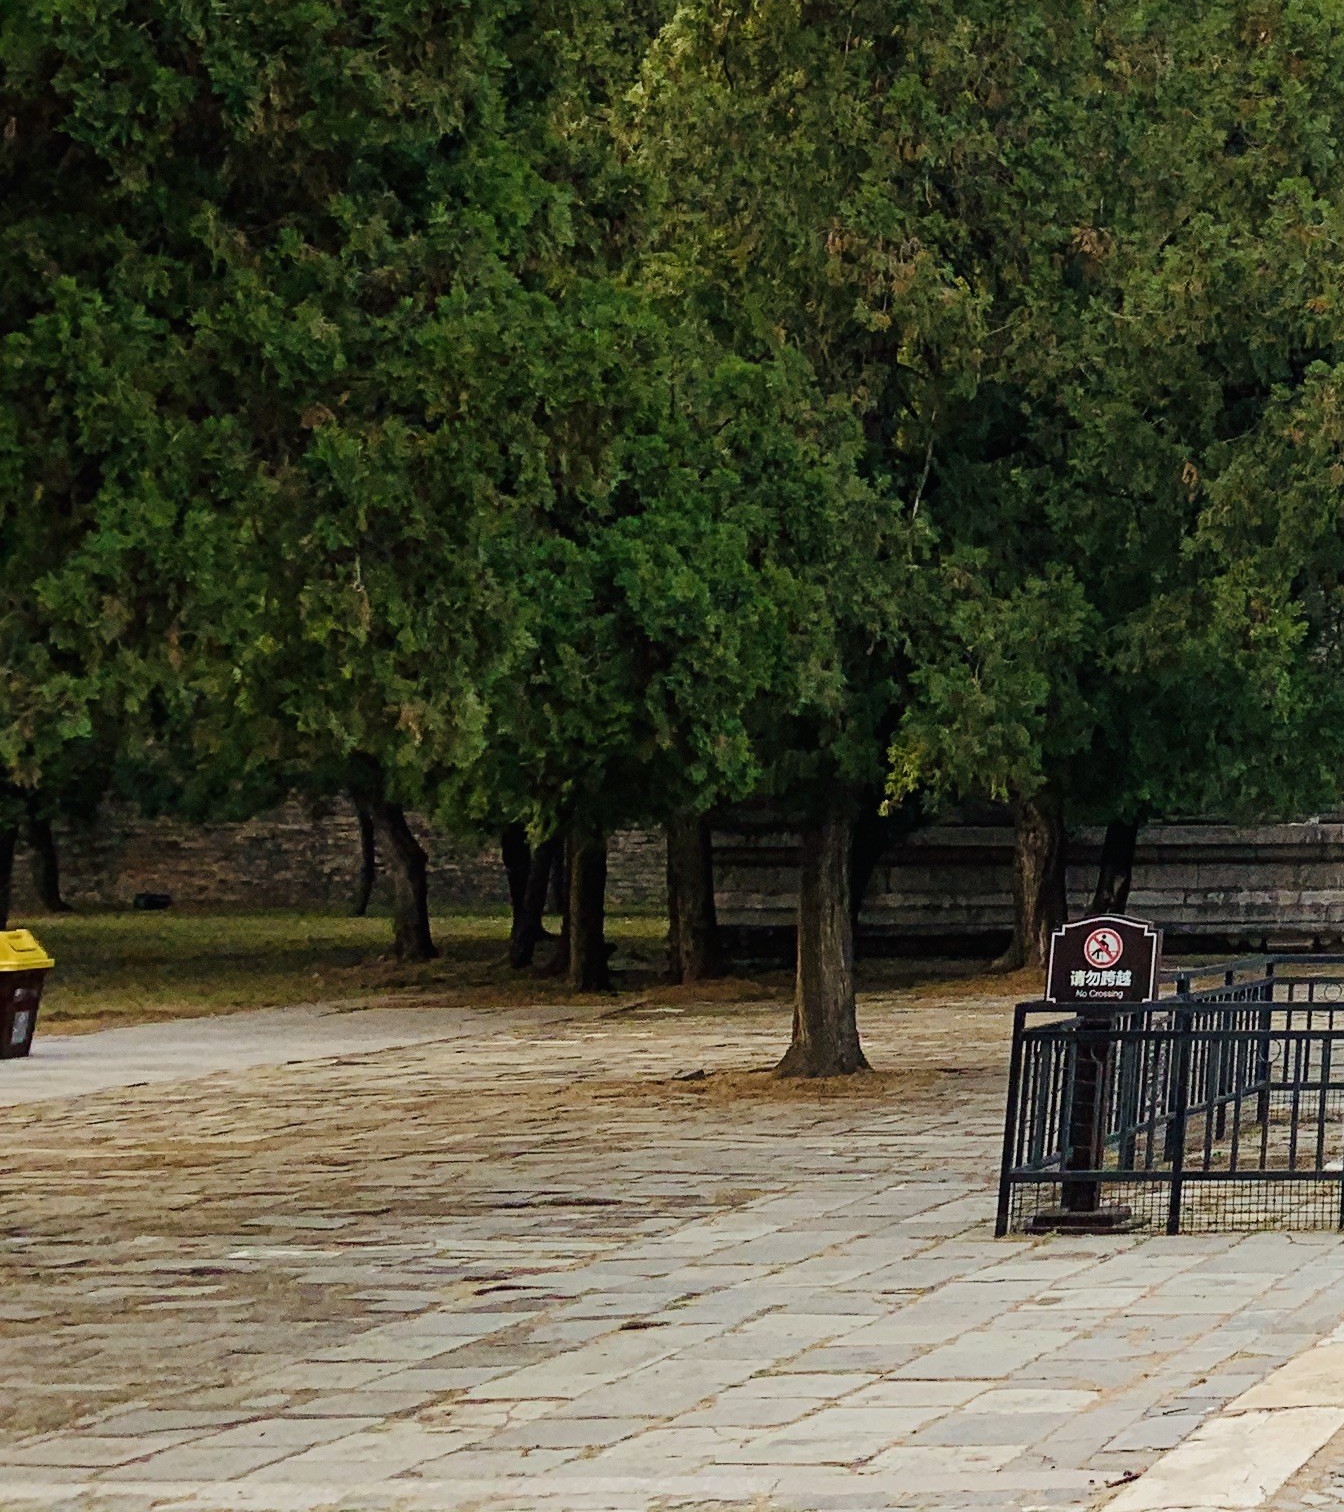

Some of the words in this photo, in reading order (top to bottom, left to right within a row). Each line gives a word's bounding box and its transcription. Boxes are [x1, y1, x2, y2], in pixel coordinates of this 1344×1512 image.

[1070, 970, 1132, 987] 请勿跨越
[1075, 989, 1088, 998] No
[1089, 989, 1124, 999] Crossing
